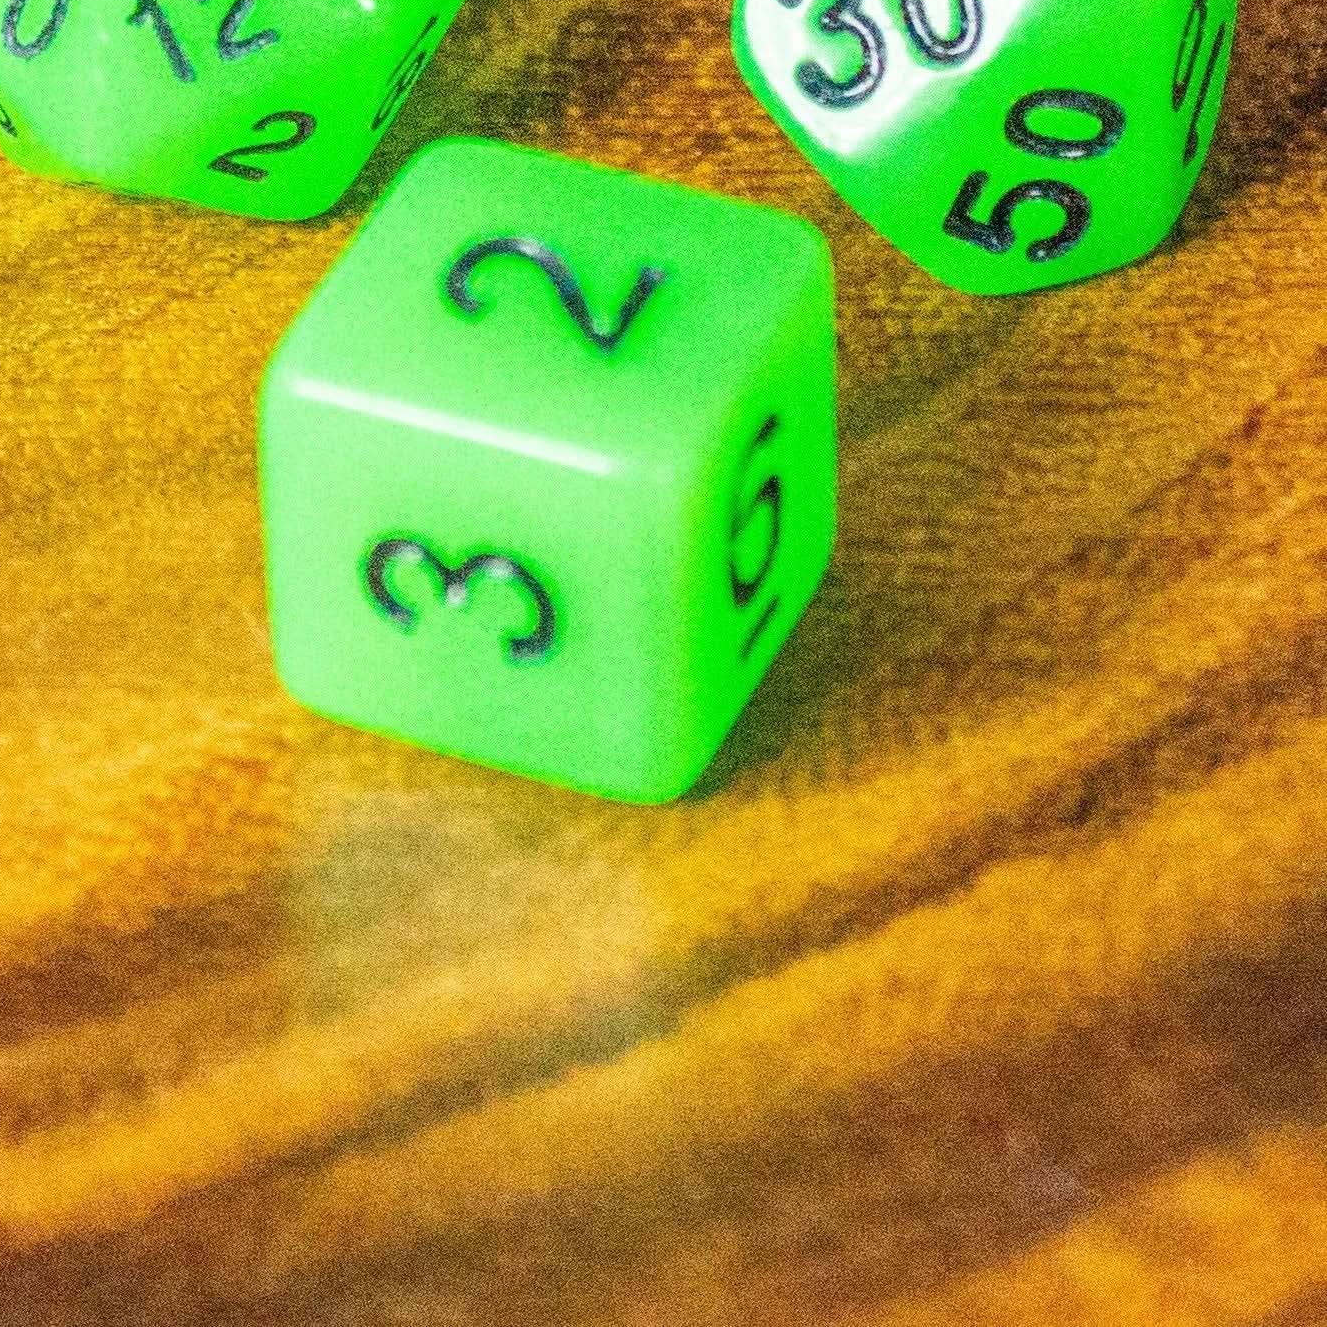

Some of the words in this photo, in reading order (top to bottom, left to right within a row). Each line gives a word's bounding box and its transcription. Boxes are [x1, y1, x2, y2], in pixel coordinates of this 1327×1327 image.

[208, 110, 317, 182] 2
[943, 88, 1126, 263] 50
[444, 236, 666, 353] 2
[364, 537, 559, 661] 3
